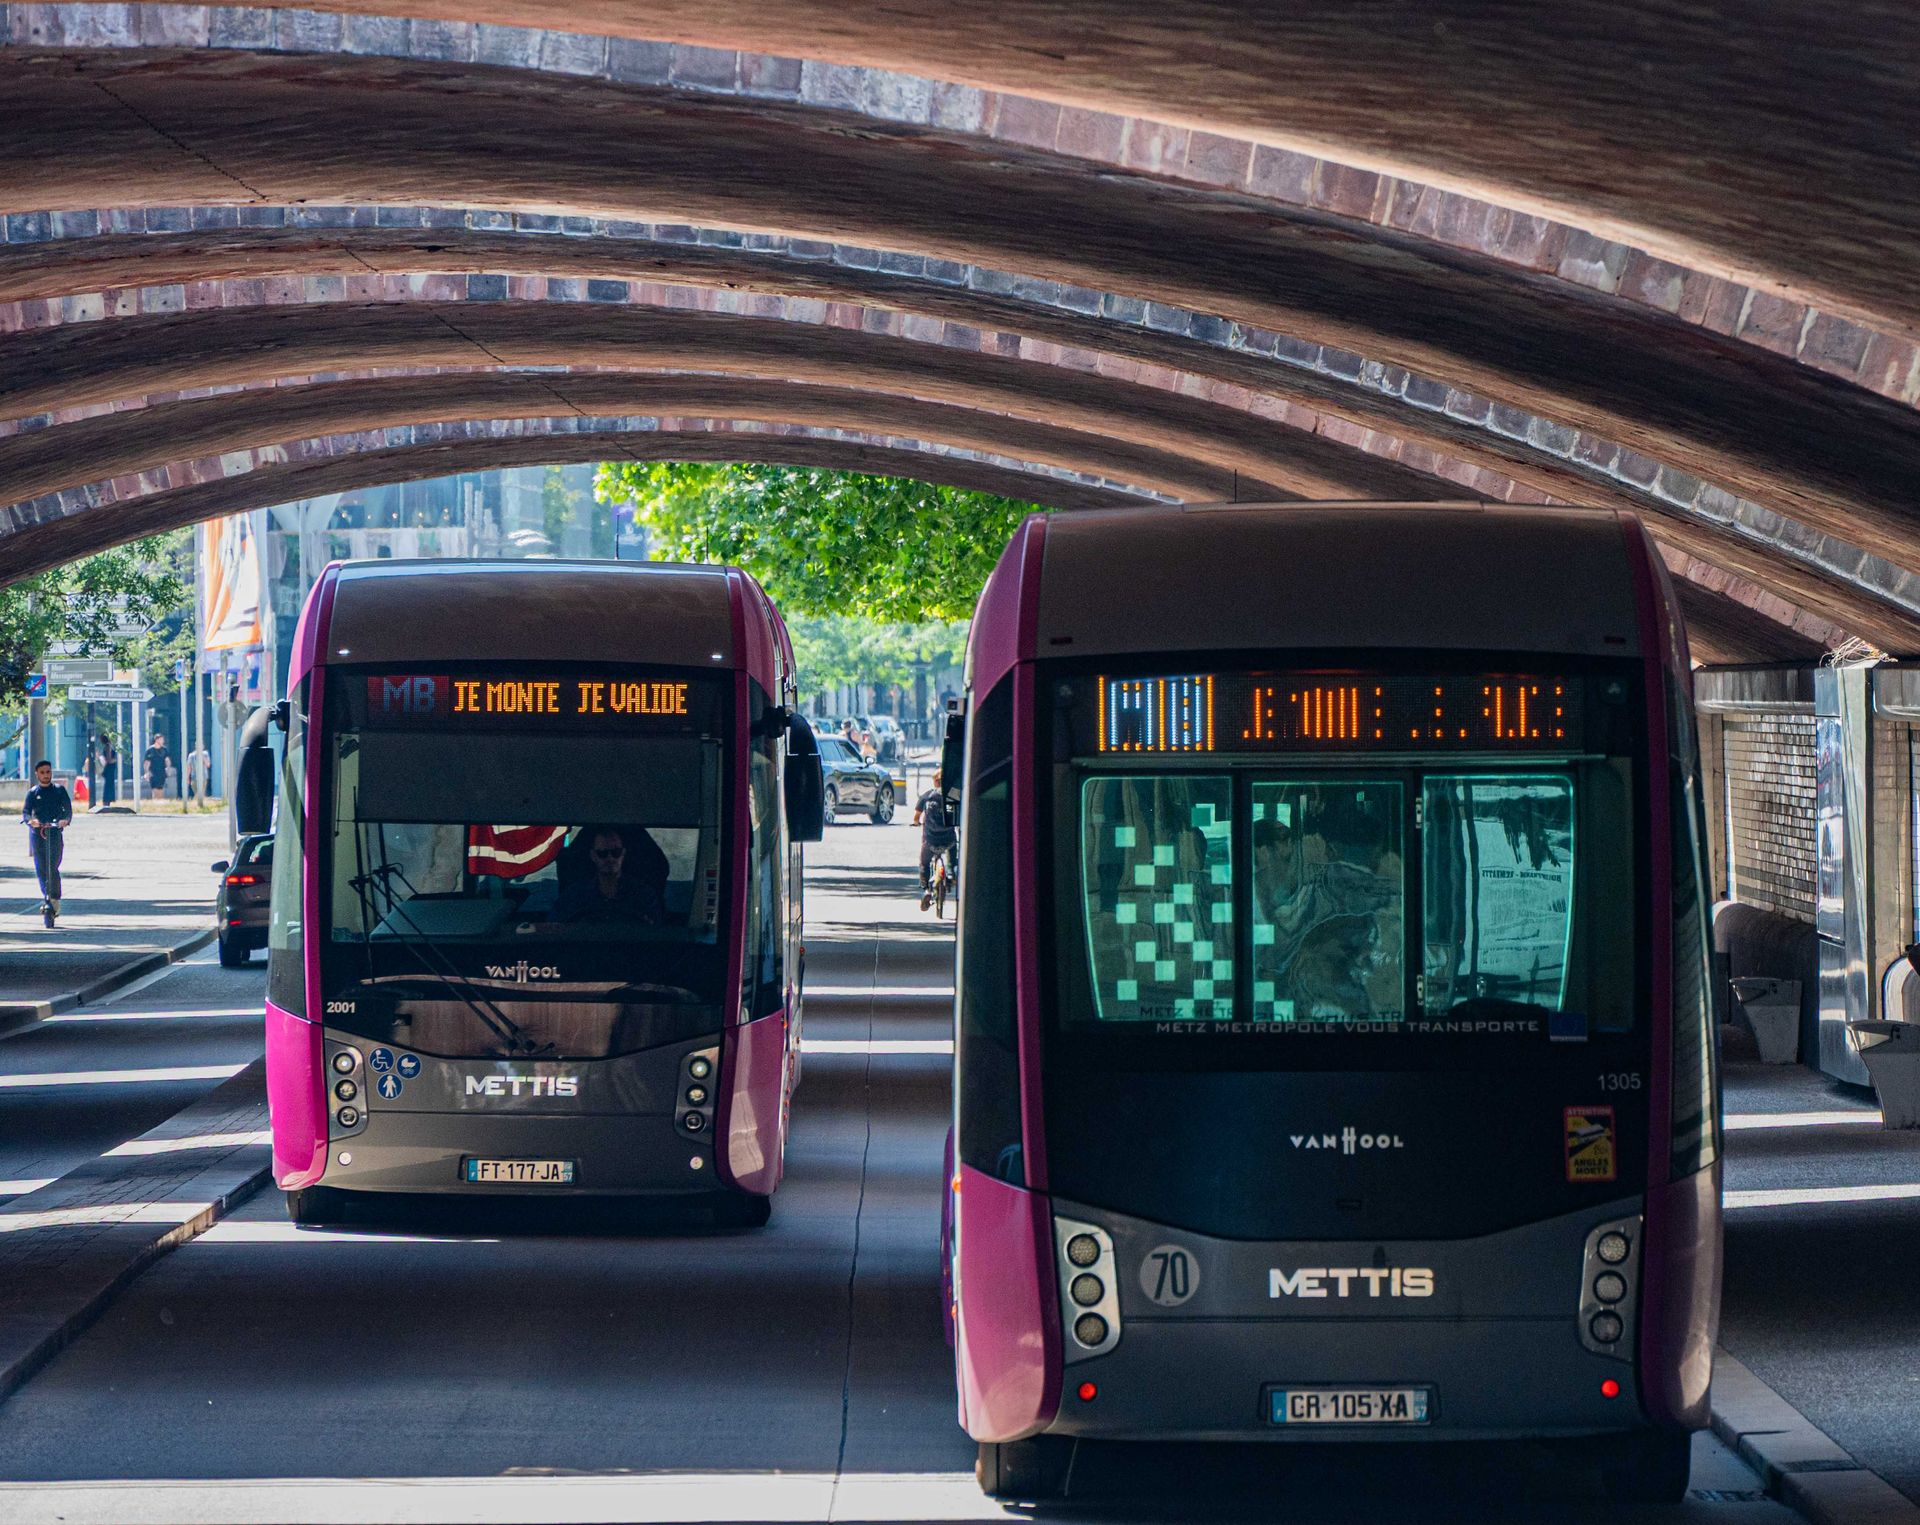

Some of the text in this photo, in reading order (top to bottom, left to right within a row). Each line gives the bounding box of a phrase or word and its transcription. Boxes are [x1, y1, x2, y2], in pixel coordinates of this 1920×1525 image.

[383, 677, 435, 712] MB
[454, 682, 688, 714] JE MONTE JE VALIDE
[326, 1002, 356, 1013] 2001
[1156, 1020, 1539, 1033] METZ METROPOLE VOUS TRANSPORTE
[465, 1075, 578, 1096] METTIS
[1598, 1072, 1642, 1091] 1305
[1574, 1158, 1609, 1167] ANGLES
[1576, 1167, 1608, 1175] MORTS
[1151, 1251, 1190, 1300] 70
[1268, 1267, 1434, 1298] METTIS
[1415, 1406, 1426, 1419] 57
